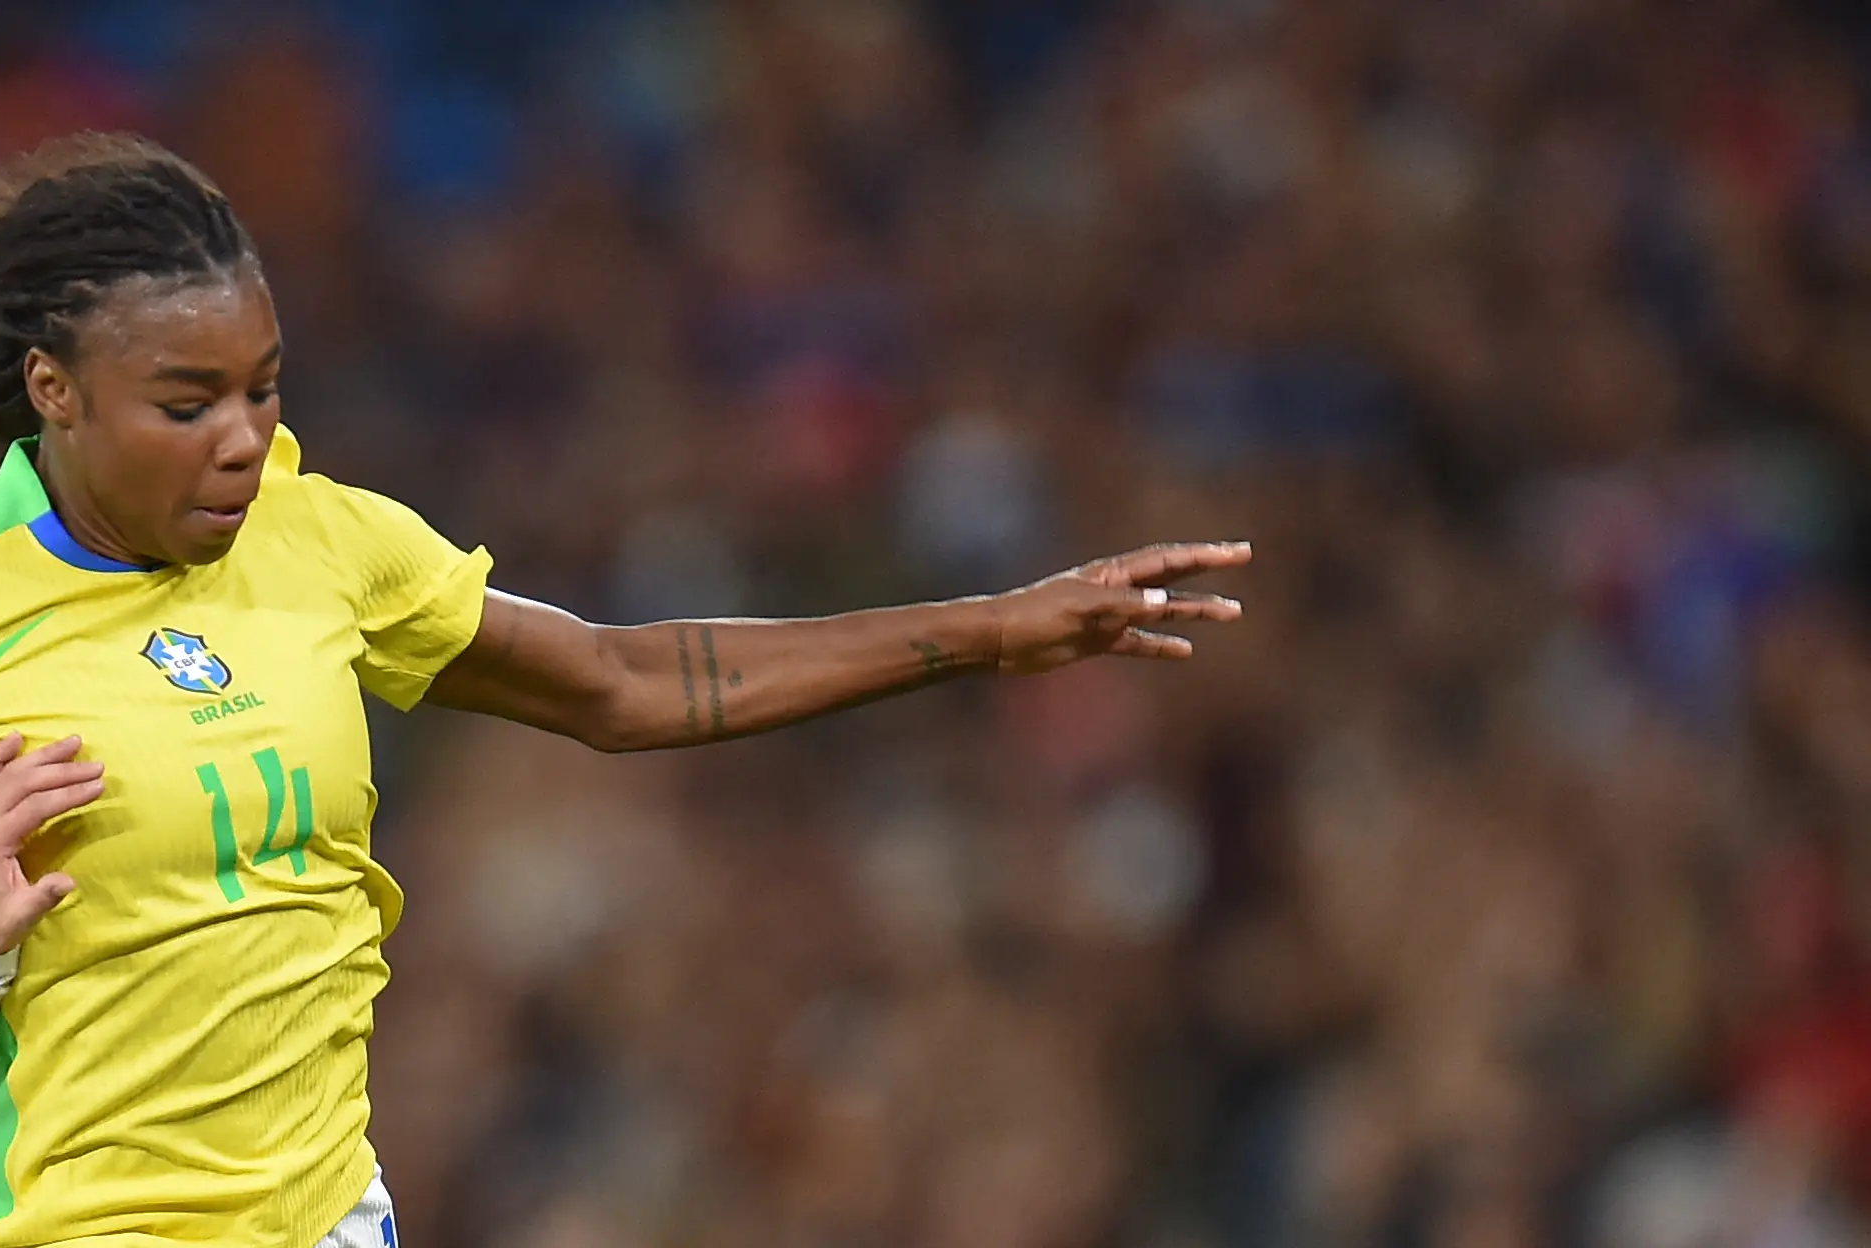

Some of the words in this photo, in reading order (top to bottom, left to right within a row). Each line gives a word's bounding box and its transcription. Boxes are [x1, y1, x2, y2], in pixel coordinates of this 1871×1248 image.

[174, 656, 197, 668] CBF
[190, 692, 265, 725] BRASIL
[195, 747, 313, 903] 14
